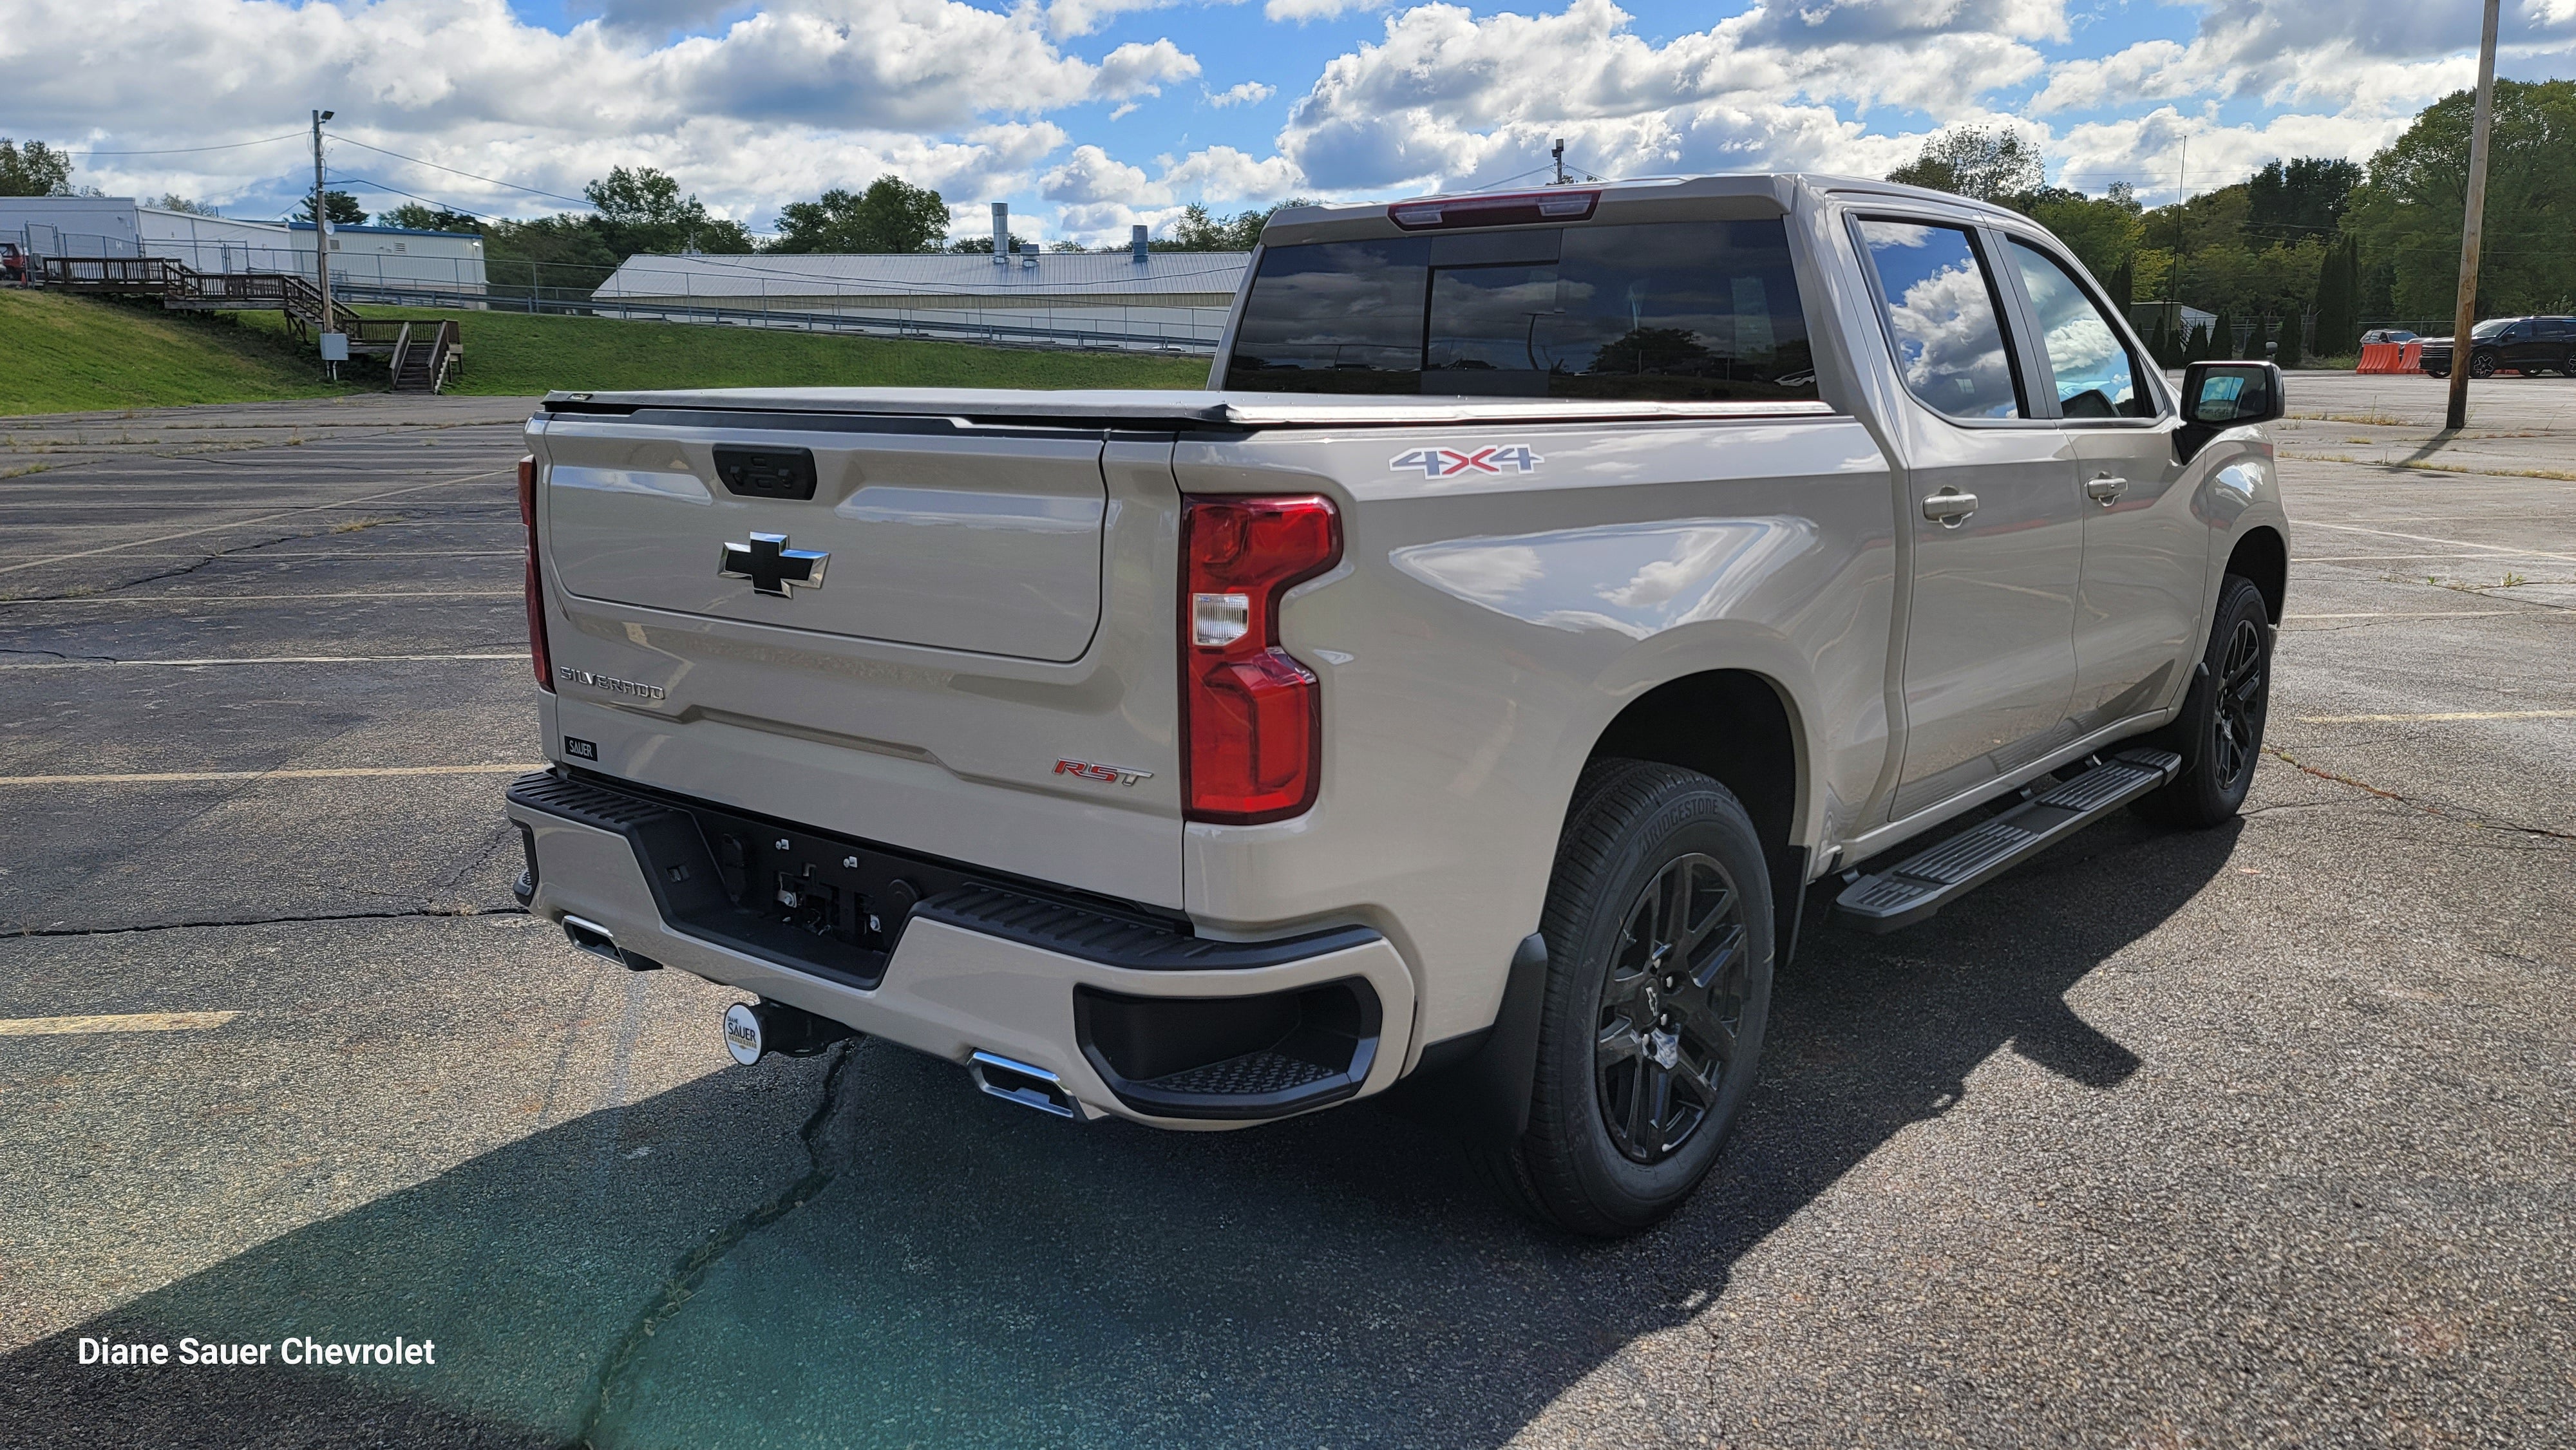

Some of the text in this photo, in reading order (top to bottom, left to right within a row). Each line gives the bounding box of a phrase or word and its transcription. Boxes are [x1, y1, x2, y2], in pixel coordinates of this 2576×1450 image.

[560, 666, 665, 699] SILVERADO
[569, 740, 593, 758] SAUER
[1052, 757, 1154, 786] RST
[728, 1022, 757, 1043] SAUER
